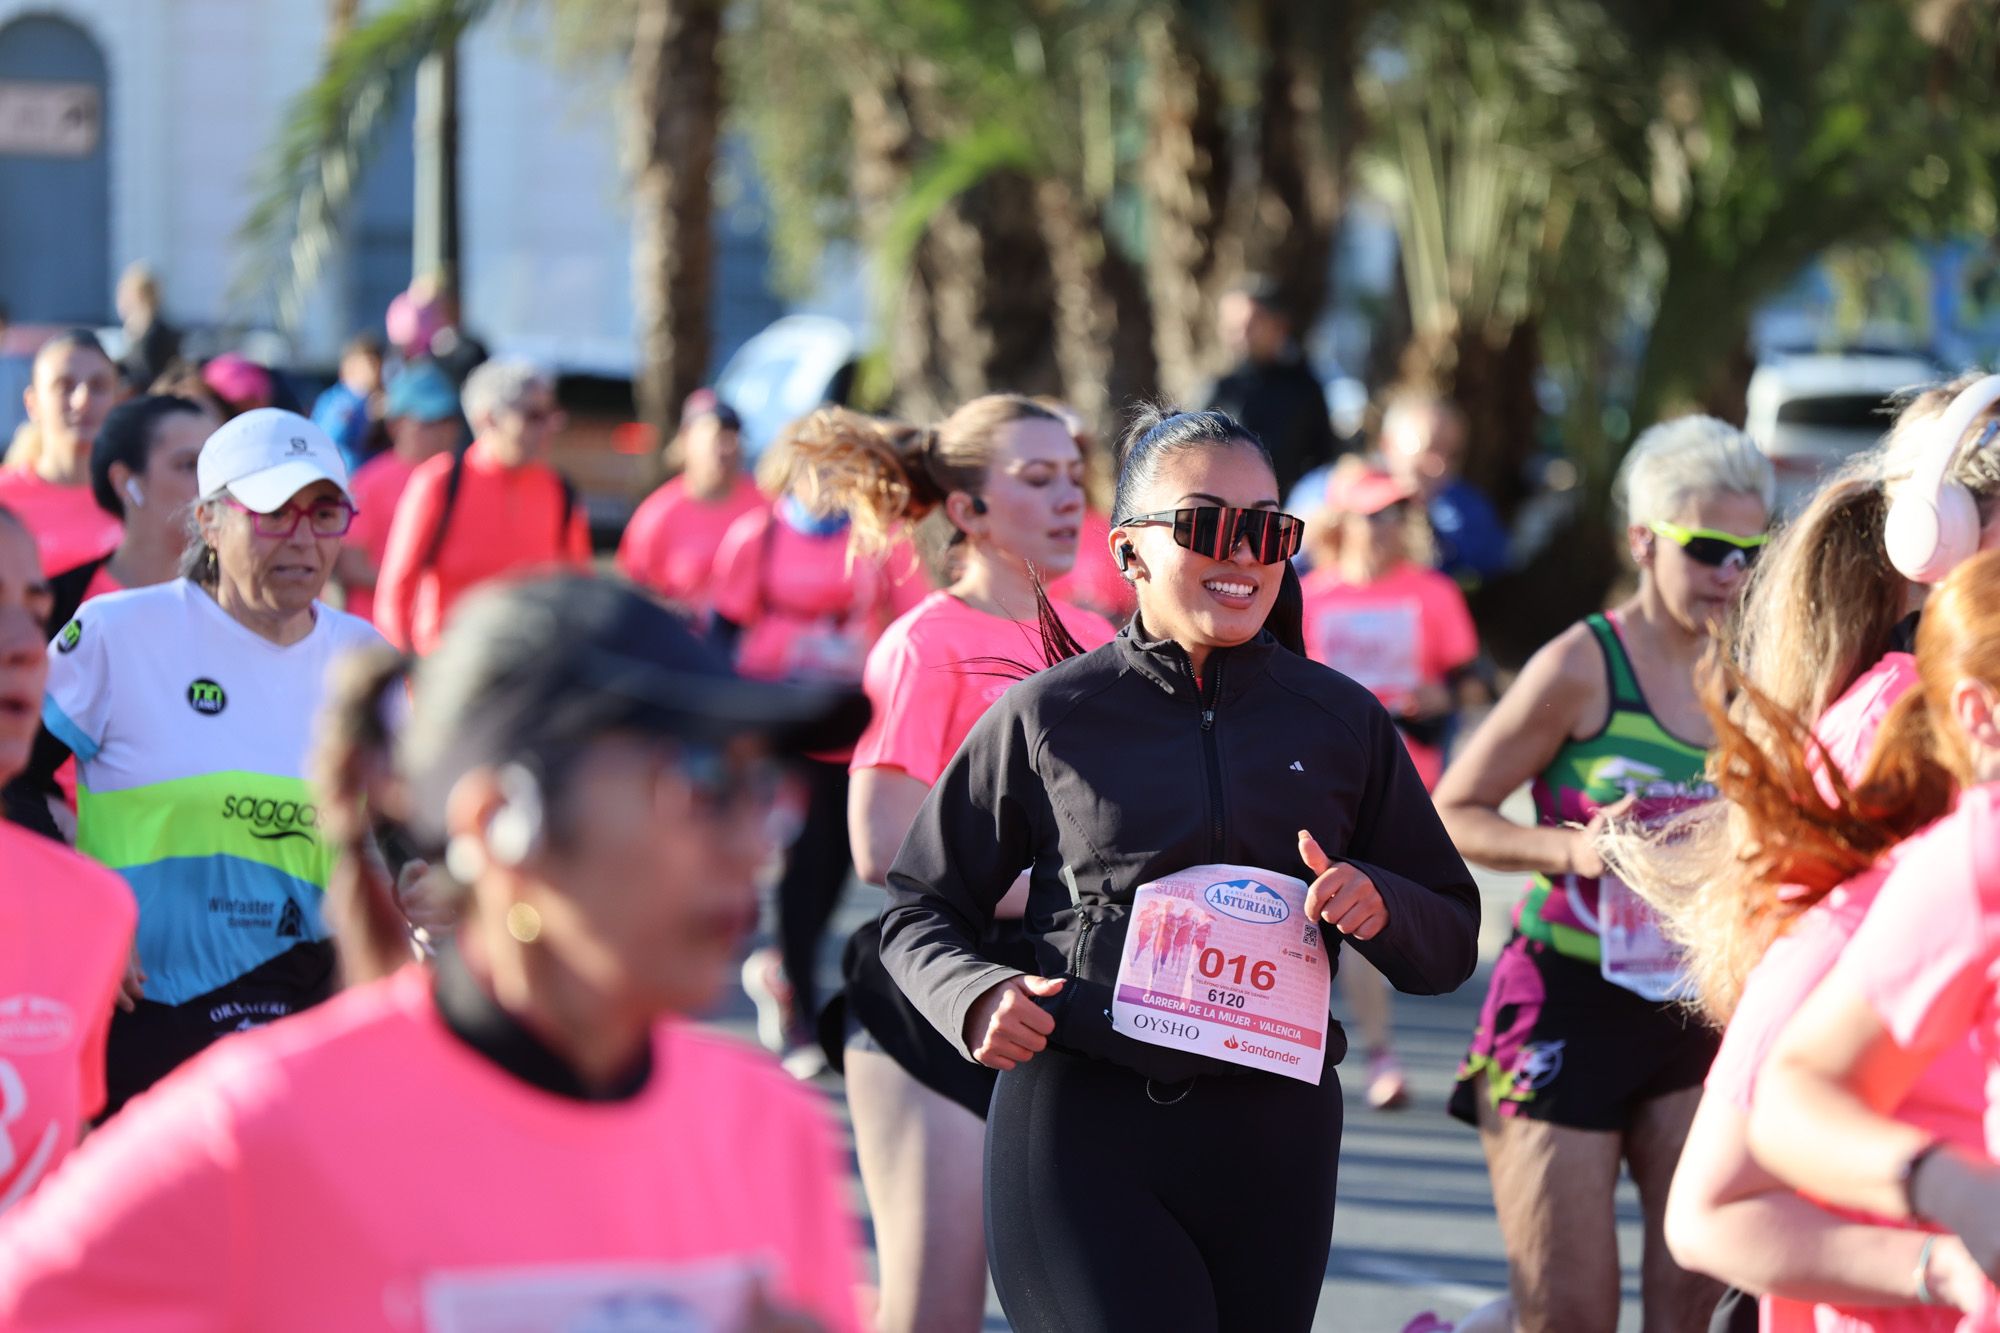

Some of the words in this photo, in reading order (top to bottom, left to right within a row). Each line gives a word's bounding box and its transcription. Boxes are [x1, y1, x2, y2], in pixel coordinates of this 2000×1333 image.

[222, 796, 320, 831] sagga
[1154, 885, 1194, 901] SUMA
[1210, 888, 1283, 919] ASTURIANA
[1198, 947, 1278, 992] 016
[1208, 989, 1245, 1009] 6120
[1134, 1014, 1200, 1041] OYSHO
[1142, 994, 1186, 1012] CARRERA
[1188, 1004, 1202, 1016] DE
[1203, 1007, 1216, 1019] LA
[1218, 1010, 1251, 1027] MUJER
[1259, 1020, 1302, 1040] VALENCIA
[1240, 1040, 1302, 1065] Santander
